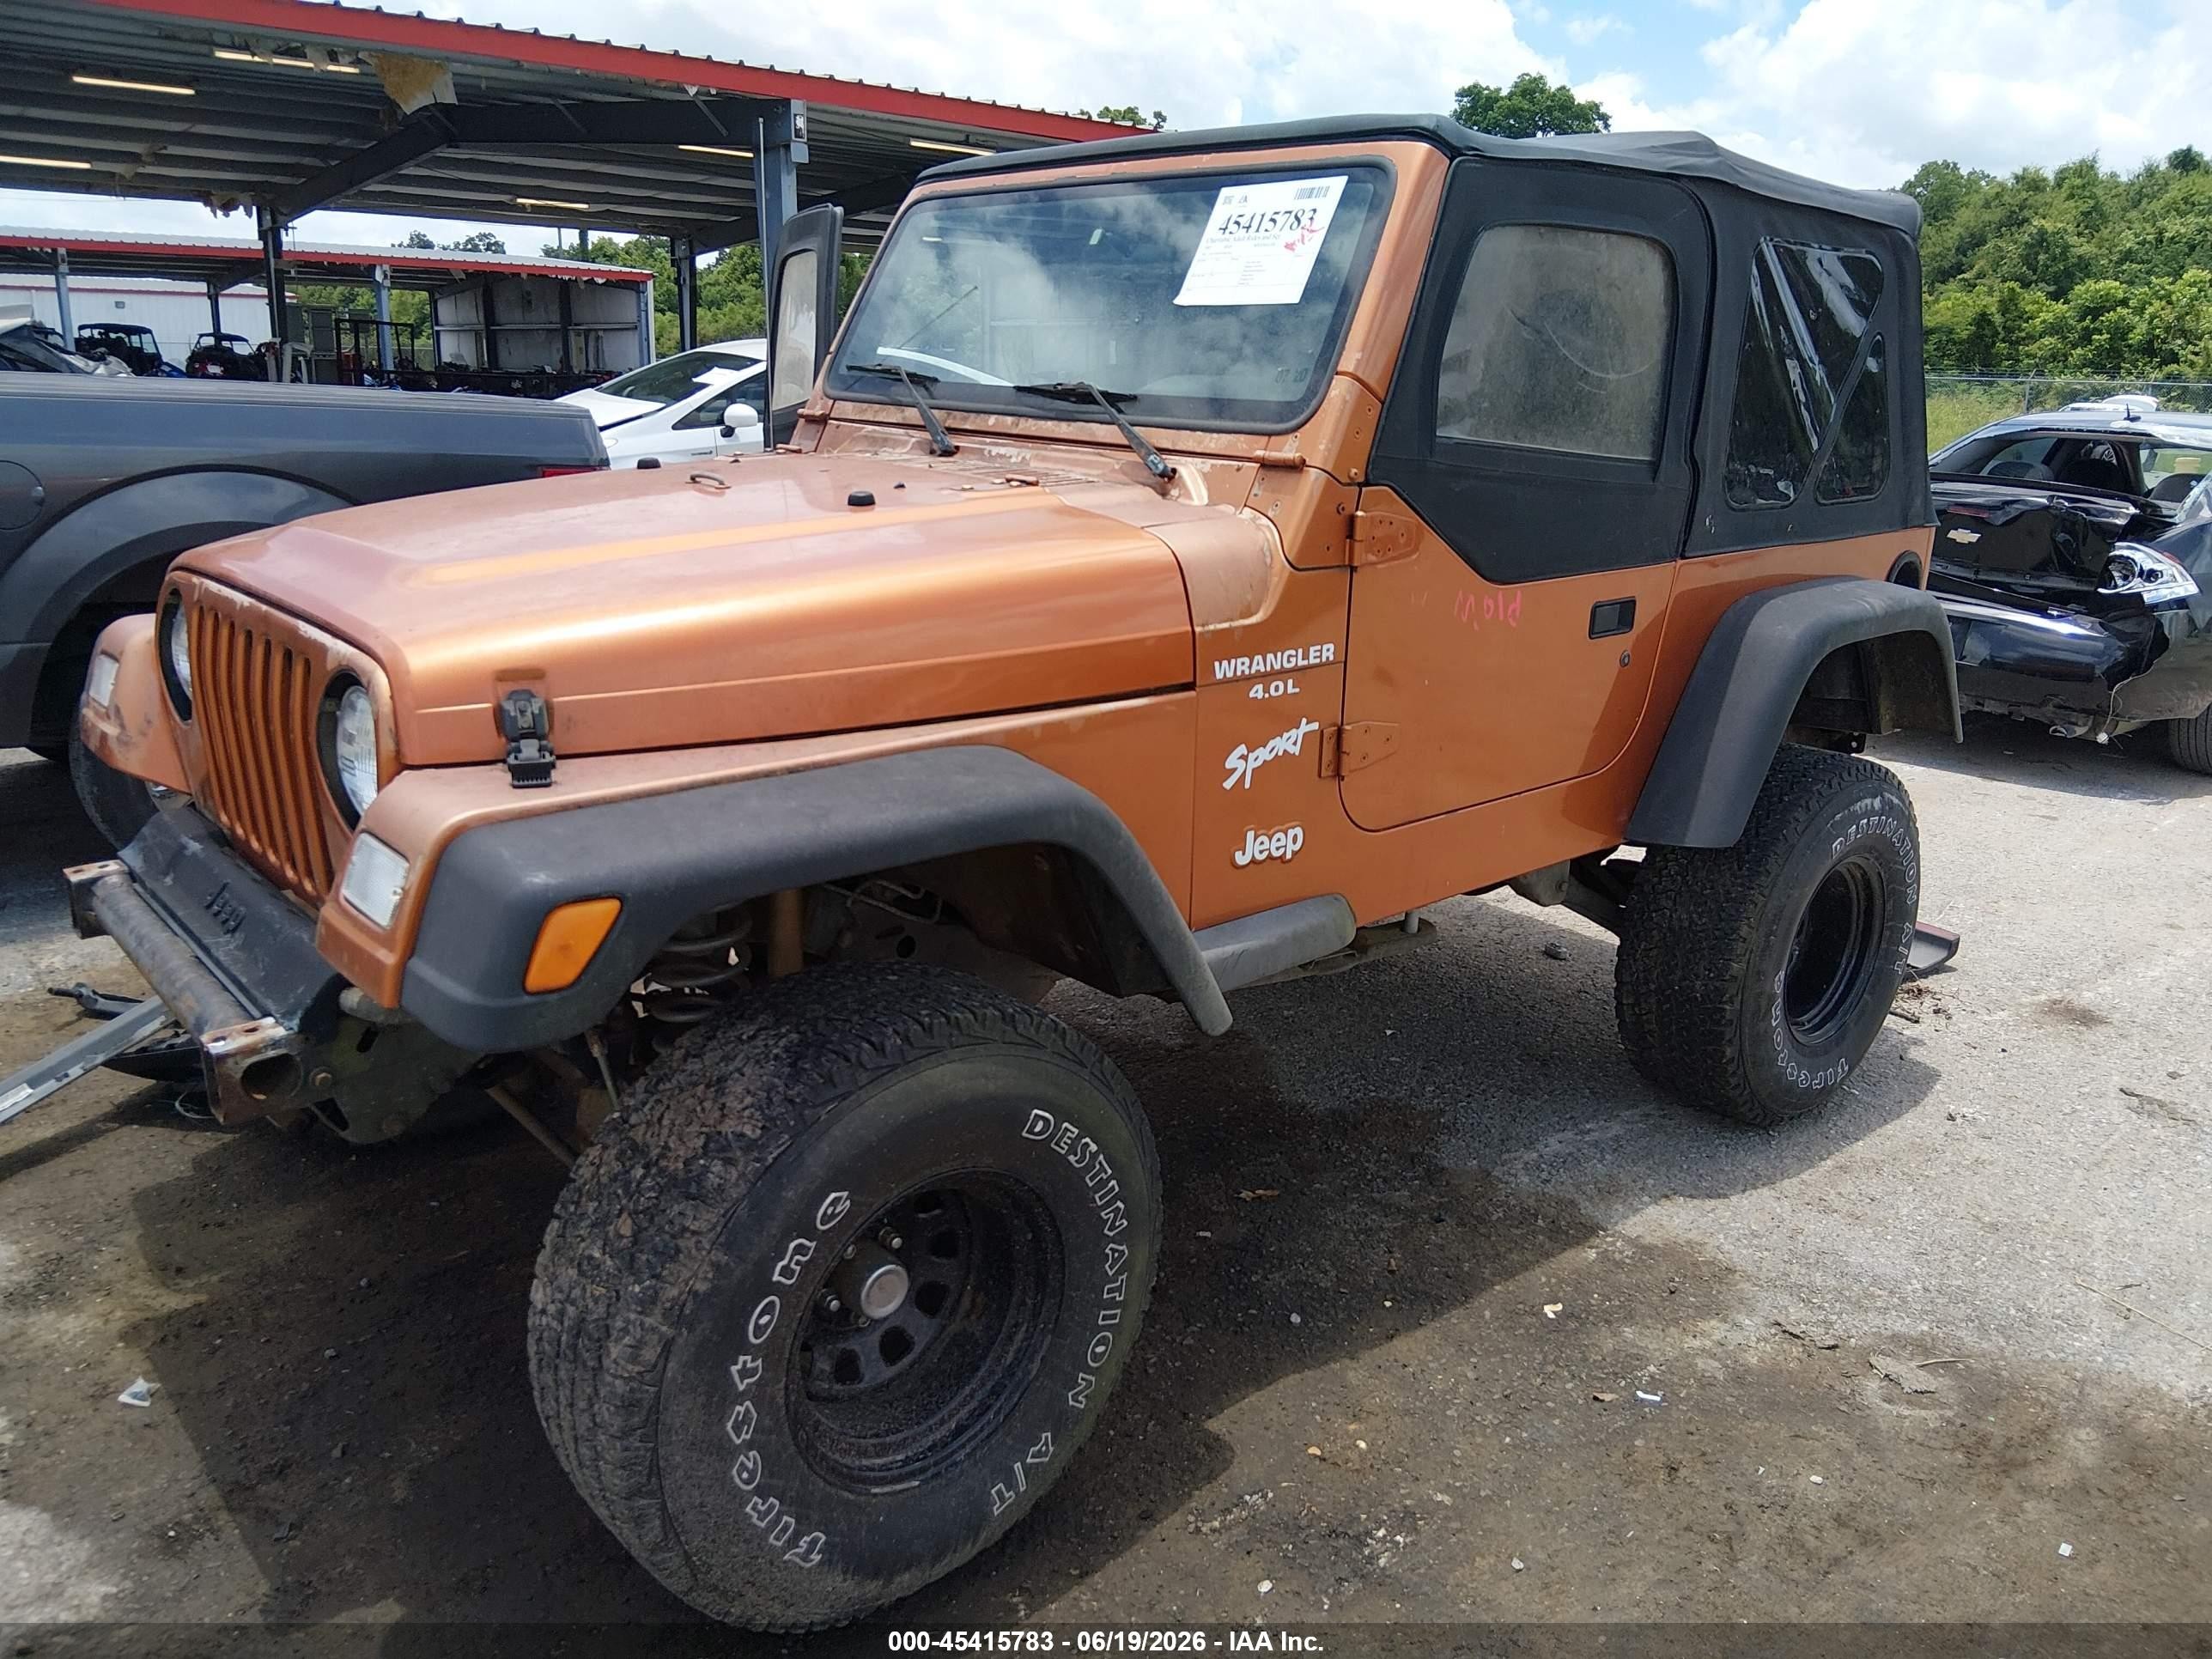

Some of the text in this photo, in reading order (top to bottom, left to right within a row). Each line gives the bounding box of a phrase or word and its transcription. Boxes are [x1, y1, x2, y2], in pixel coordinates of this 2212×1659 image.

[1218, 208, 1317, 235] 45415783
[1213, 643, 1334, 680] WRANGLER
[1249, 678, 1300, 700] 4.0L
[1234, 825, 1304, 866] Jeep
[1832, 815, 1918, 905] DESTINATION
[992, 1109, 1128, 1516] DESTINATION A/T
